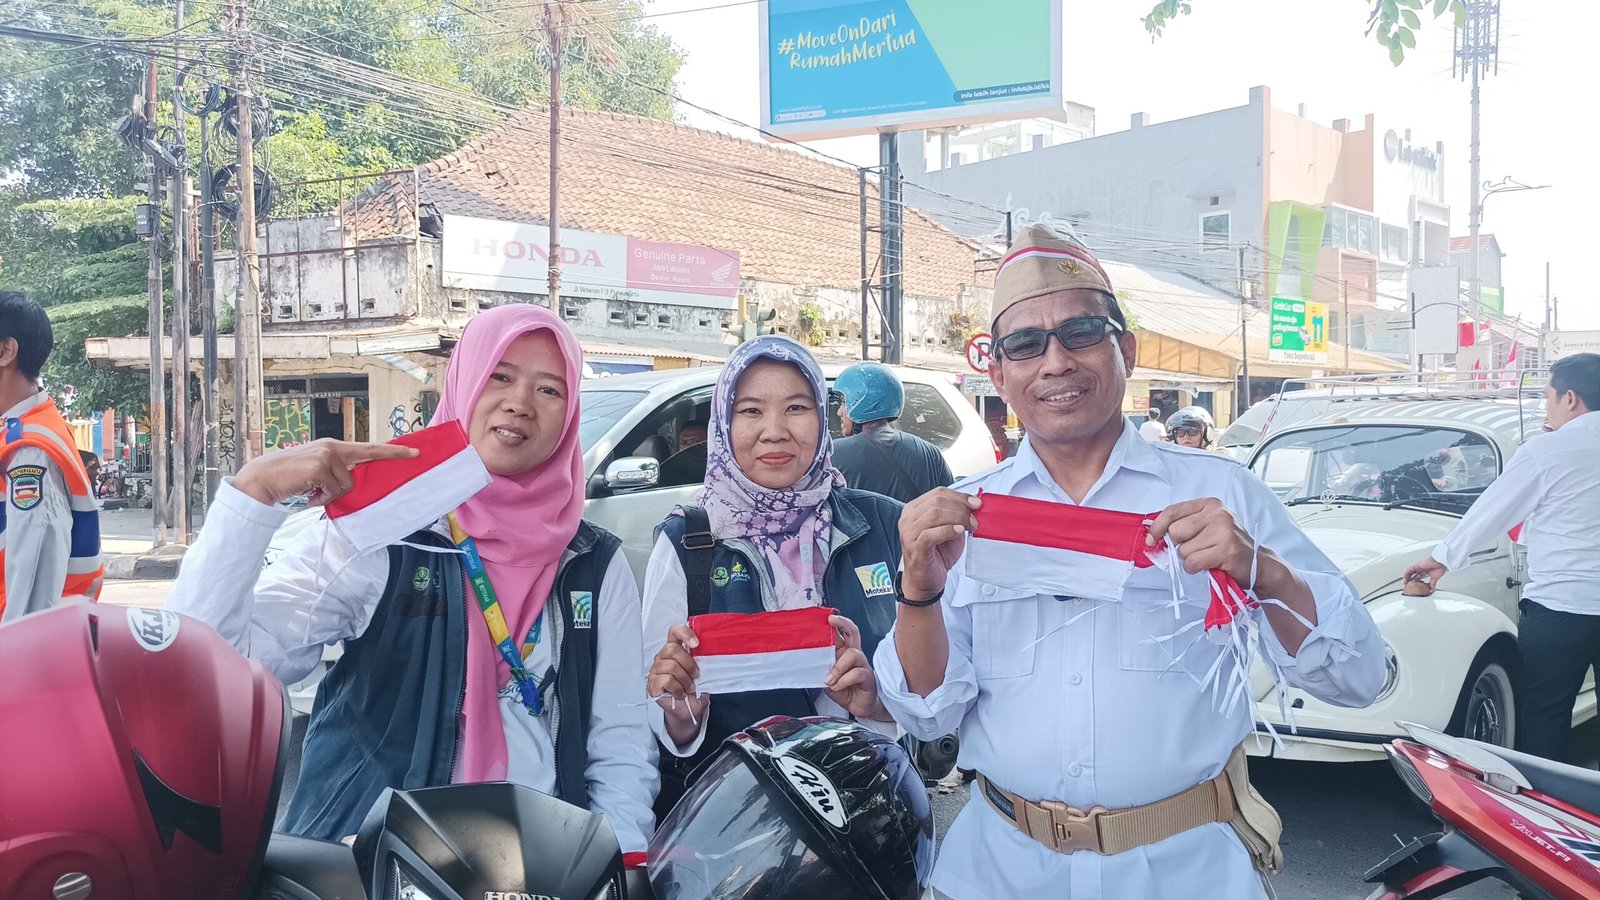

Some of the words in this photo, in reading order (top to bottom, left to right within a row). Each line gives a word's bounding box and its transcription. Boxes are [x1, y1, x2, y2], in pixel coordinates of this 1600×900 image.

[778, 10, 897, 55] #MoveOnDari
[790, 29, 917, 70] RumahMertua
[989, 88, 1008, 96] lanjut
[473, 237, 605, 268] HONDA
[634, 247, 676, 262] Genuine
[678, 253, 707, 265] Parts
[579, 286, 600, 294] Veteran
